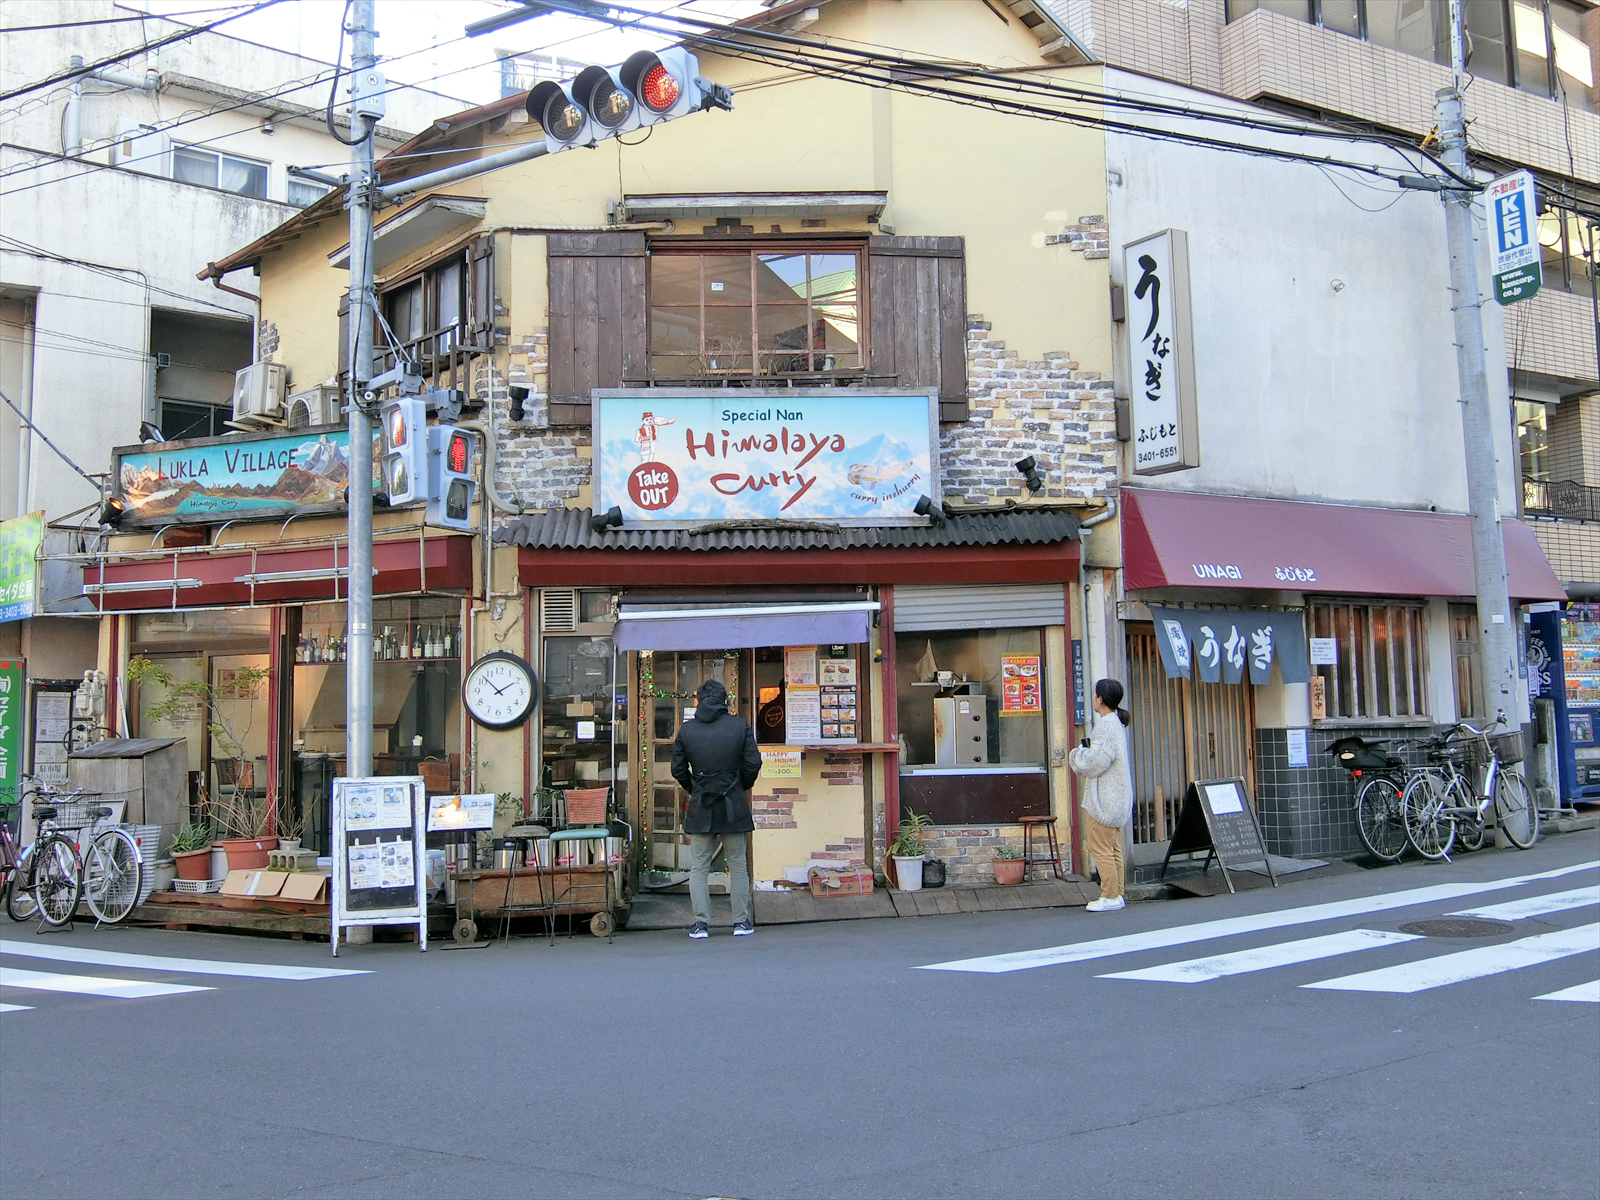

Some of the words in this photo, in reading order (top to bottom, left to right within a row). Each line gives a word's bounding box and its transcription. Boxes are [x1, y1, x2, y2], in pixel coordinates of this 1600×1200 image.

[1491, 177, 1526, 197] 不動産は
[1501, 194, 1523, 249] KEN
[1501, 269, 1524, 281] www.
[1501, 276, 1535, 290] kencorp.
[1502, 286, 1522, 298] co.jp
[1134, 254, 1171, 402] うなぎ
[721, 408, 771, 424] Special
[776, 409, 803, 421] Nan
[1138, 422, 1177, 443] ふじもと
[686, 426, 845, 471] Himalaya
[1138, 446, 1178, 463] 3401-6551
[158, 457, 209, 481] LUKLA
[224, 448, 299, 473] VILLAGE
[636, 469, 669, 488] Take
[640, 487, 669, 506] OUT
[710, 470, 817, 511] curry
[850, 491, 878, 505] curry
[1192, 563, 1243, 580] UNAGI
[1274, 566, 1317, 582] ふじもと
[1199, 624, 1274, 670] うなぎ
[486, 670, 494, 678] 11
[495, 666, 504, 675] 12
[478, 677, 488, 686] 10
[514, 677, 521, 685] 2
[474, 687, 481, 695] 9
[518, 688, 524, 696] 3
[477, 698, 484, 706] 8
[486, 705, 492, 713] 7
[513, 698, 520, 706] 4
[495, 708, 502, 717] 6
[506, 705, 512, 714] 5
